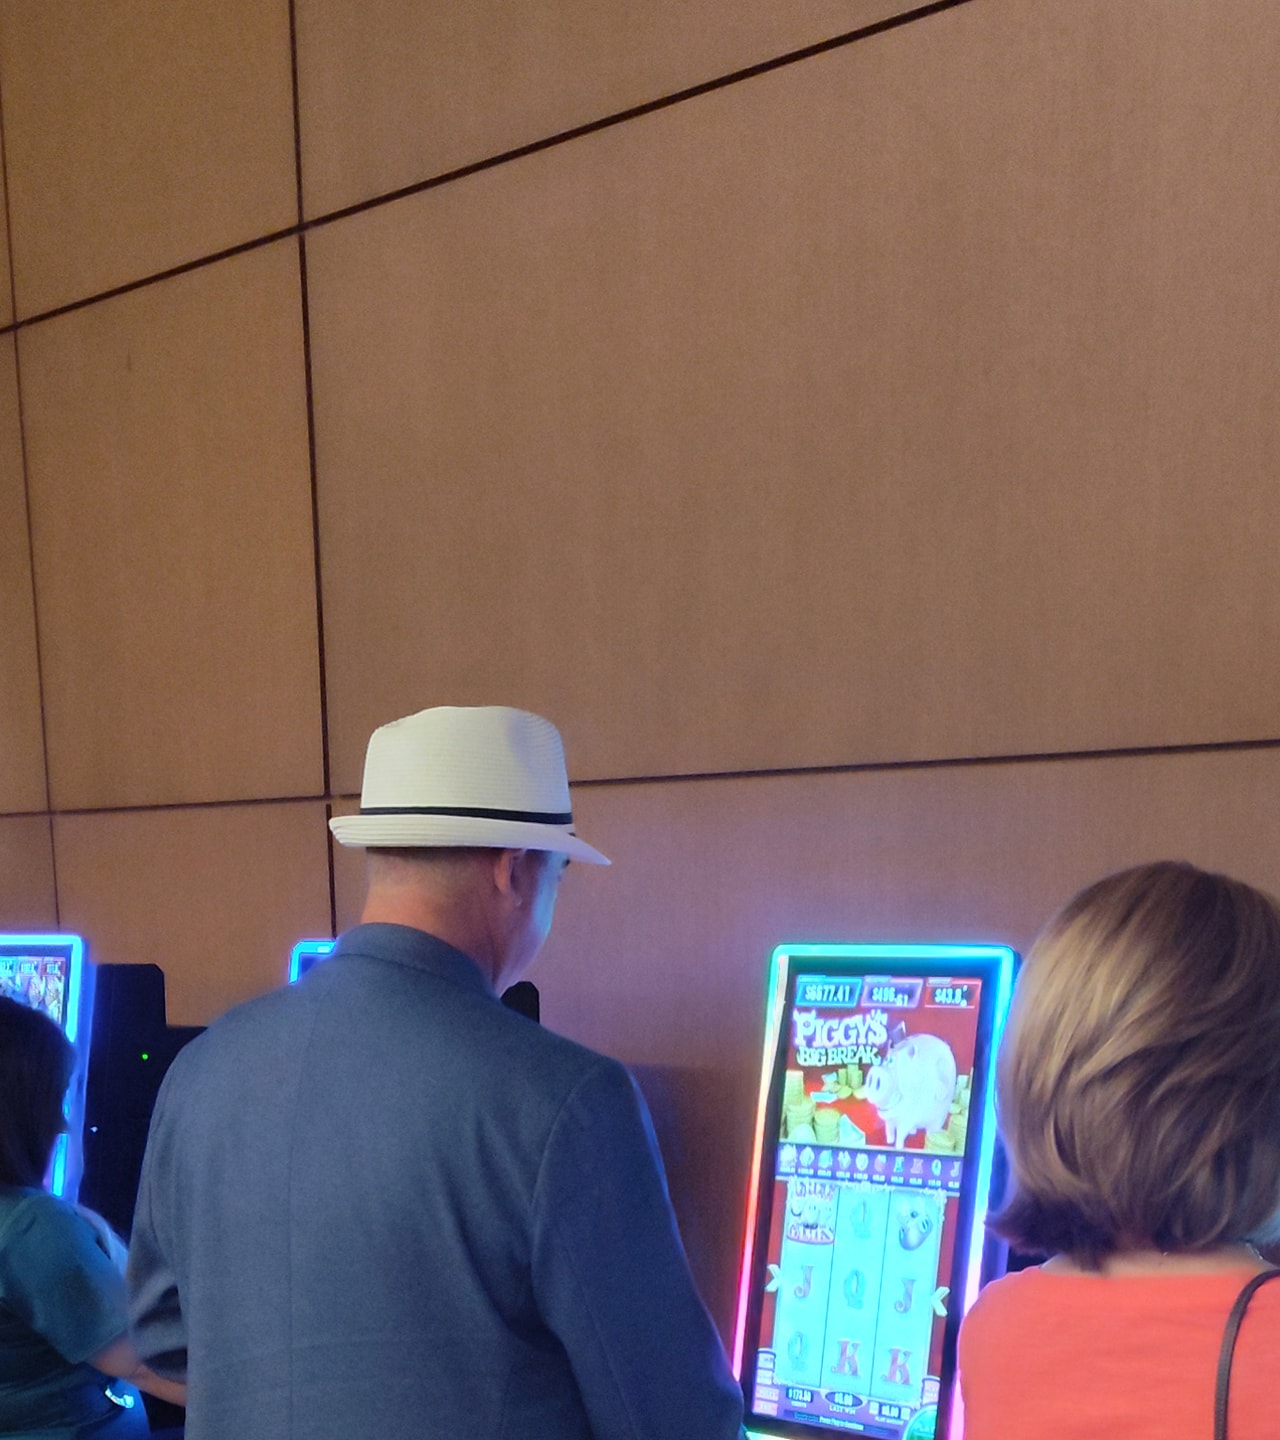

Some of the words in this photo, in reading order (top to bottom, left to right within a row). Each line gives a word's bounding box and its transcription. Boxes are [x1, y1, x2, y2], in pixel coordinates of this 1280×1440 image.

[797, 1046, 827, 1066] BIG
[827, 1045, 881, 1065] BREAK
[831, 1340, 861, 1377] K
[880, 1348, 912, 1386] K
